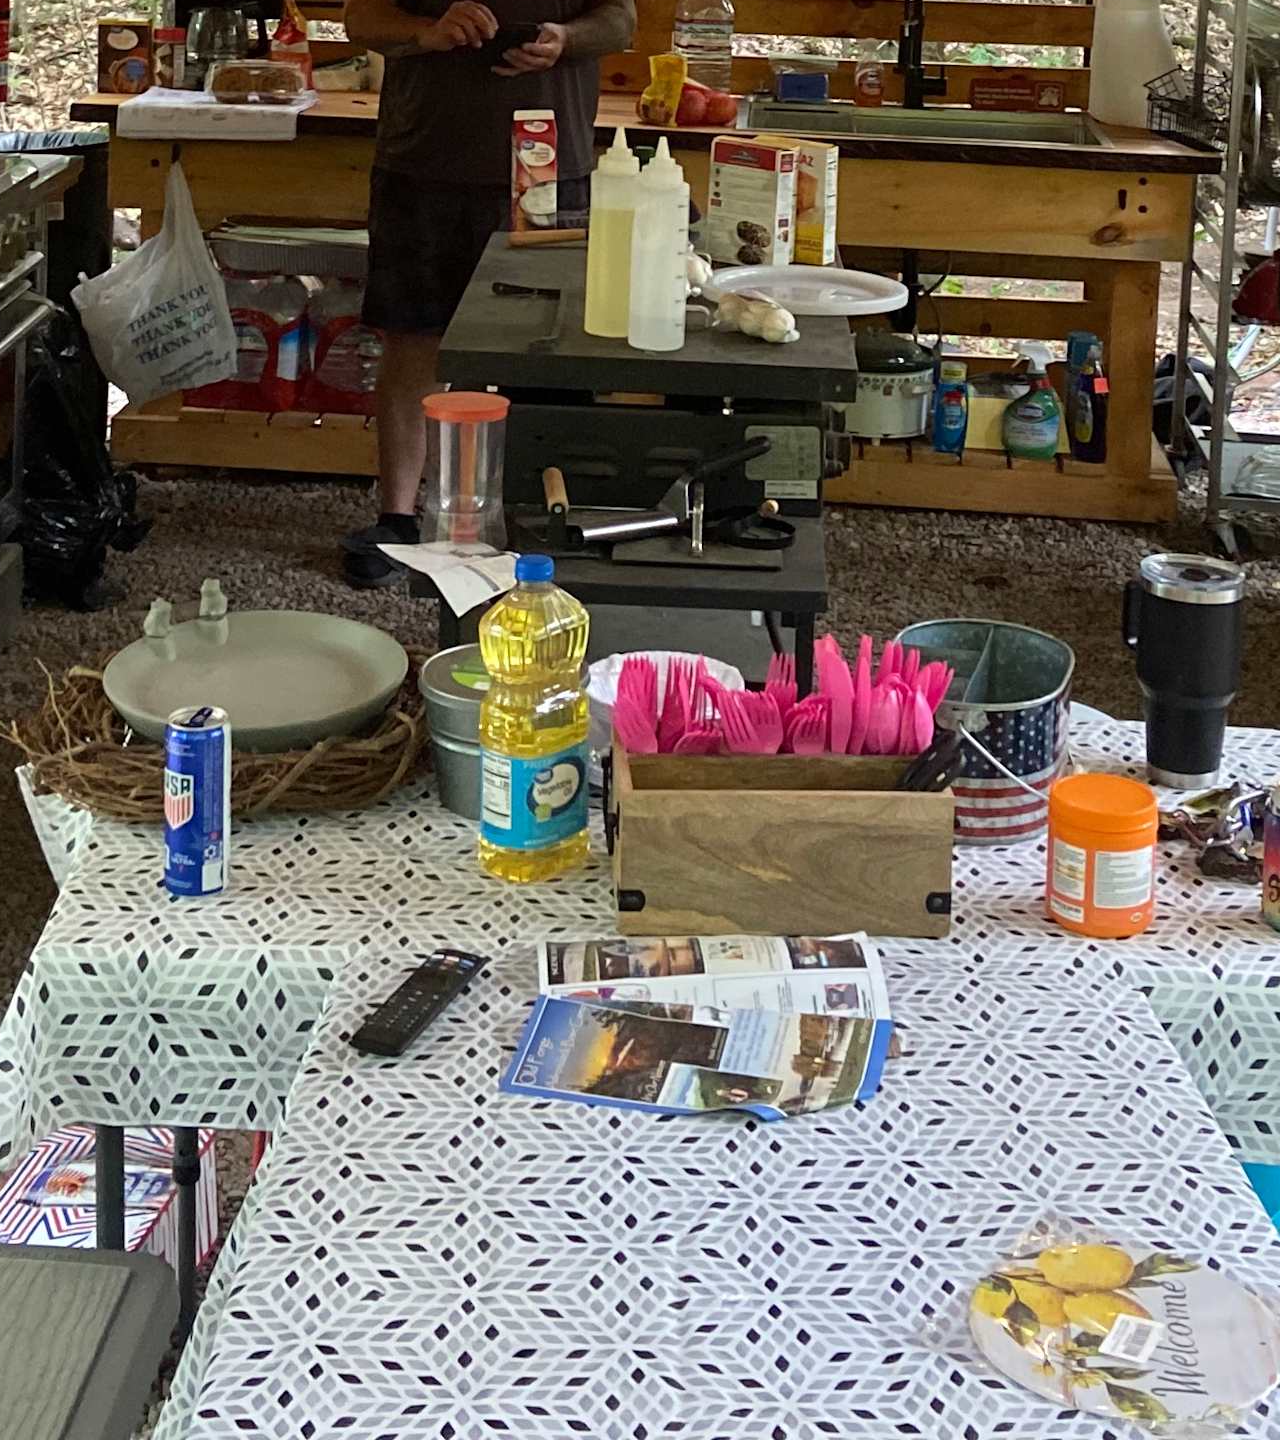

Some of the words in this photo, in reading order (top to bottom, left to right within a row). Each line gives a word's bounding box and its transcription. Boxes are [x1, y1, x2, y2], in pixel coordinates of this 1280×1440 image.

[128, 298, 179, 333] THANK
[130, 315, 187, 347] THANK
[136, 334, 192, 365] THANK
[1151, 1278, 1210, 1398] Welcome
